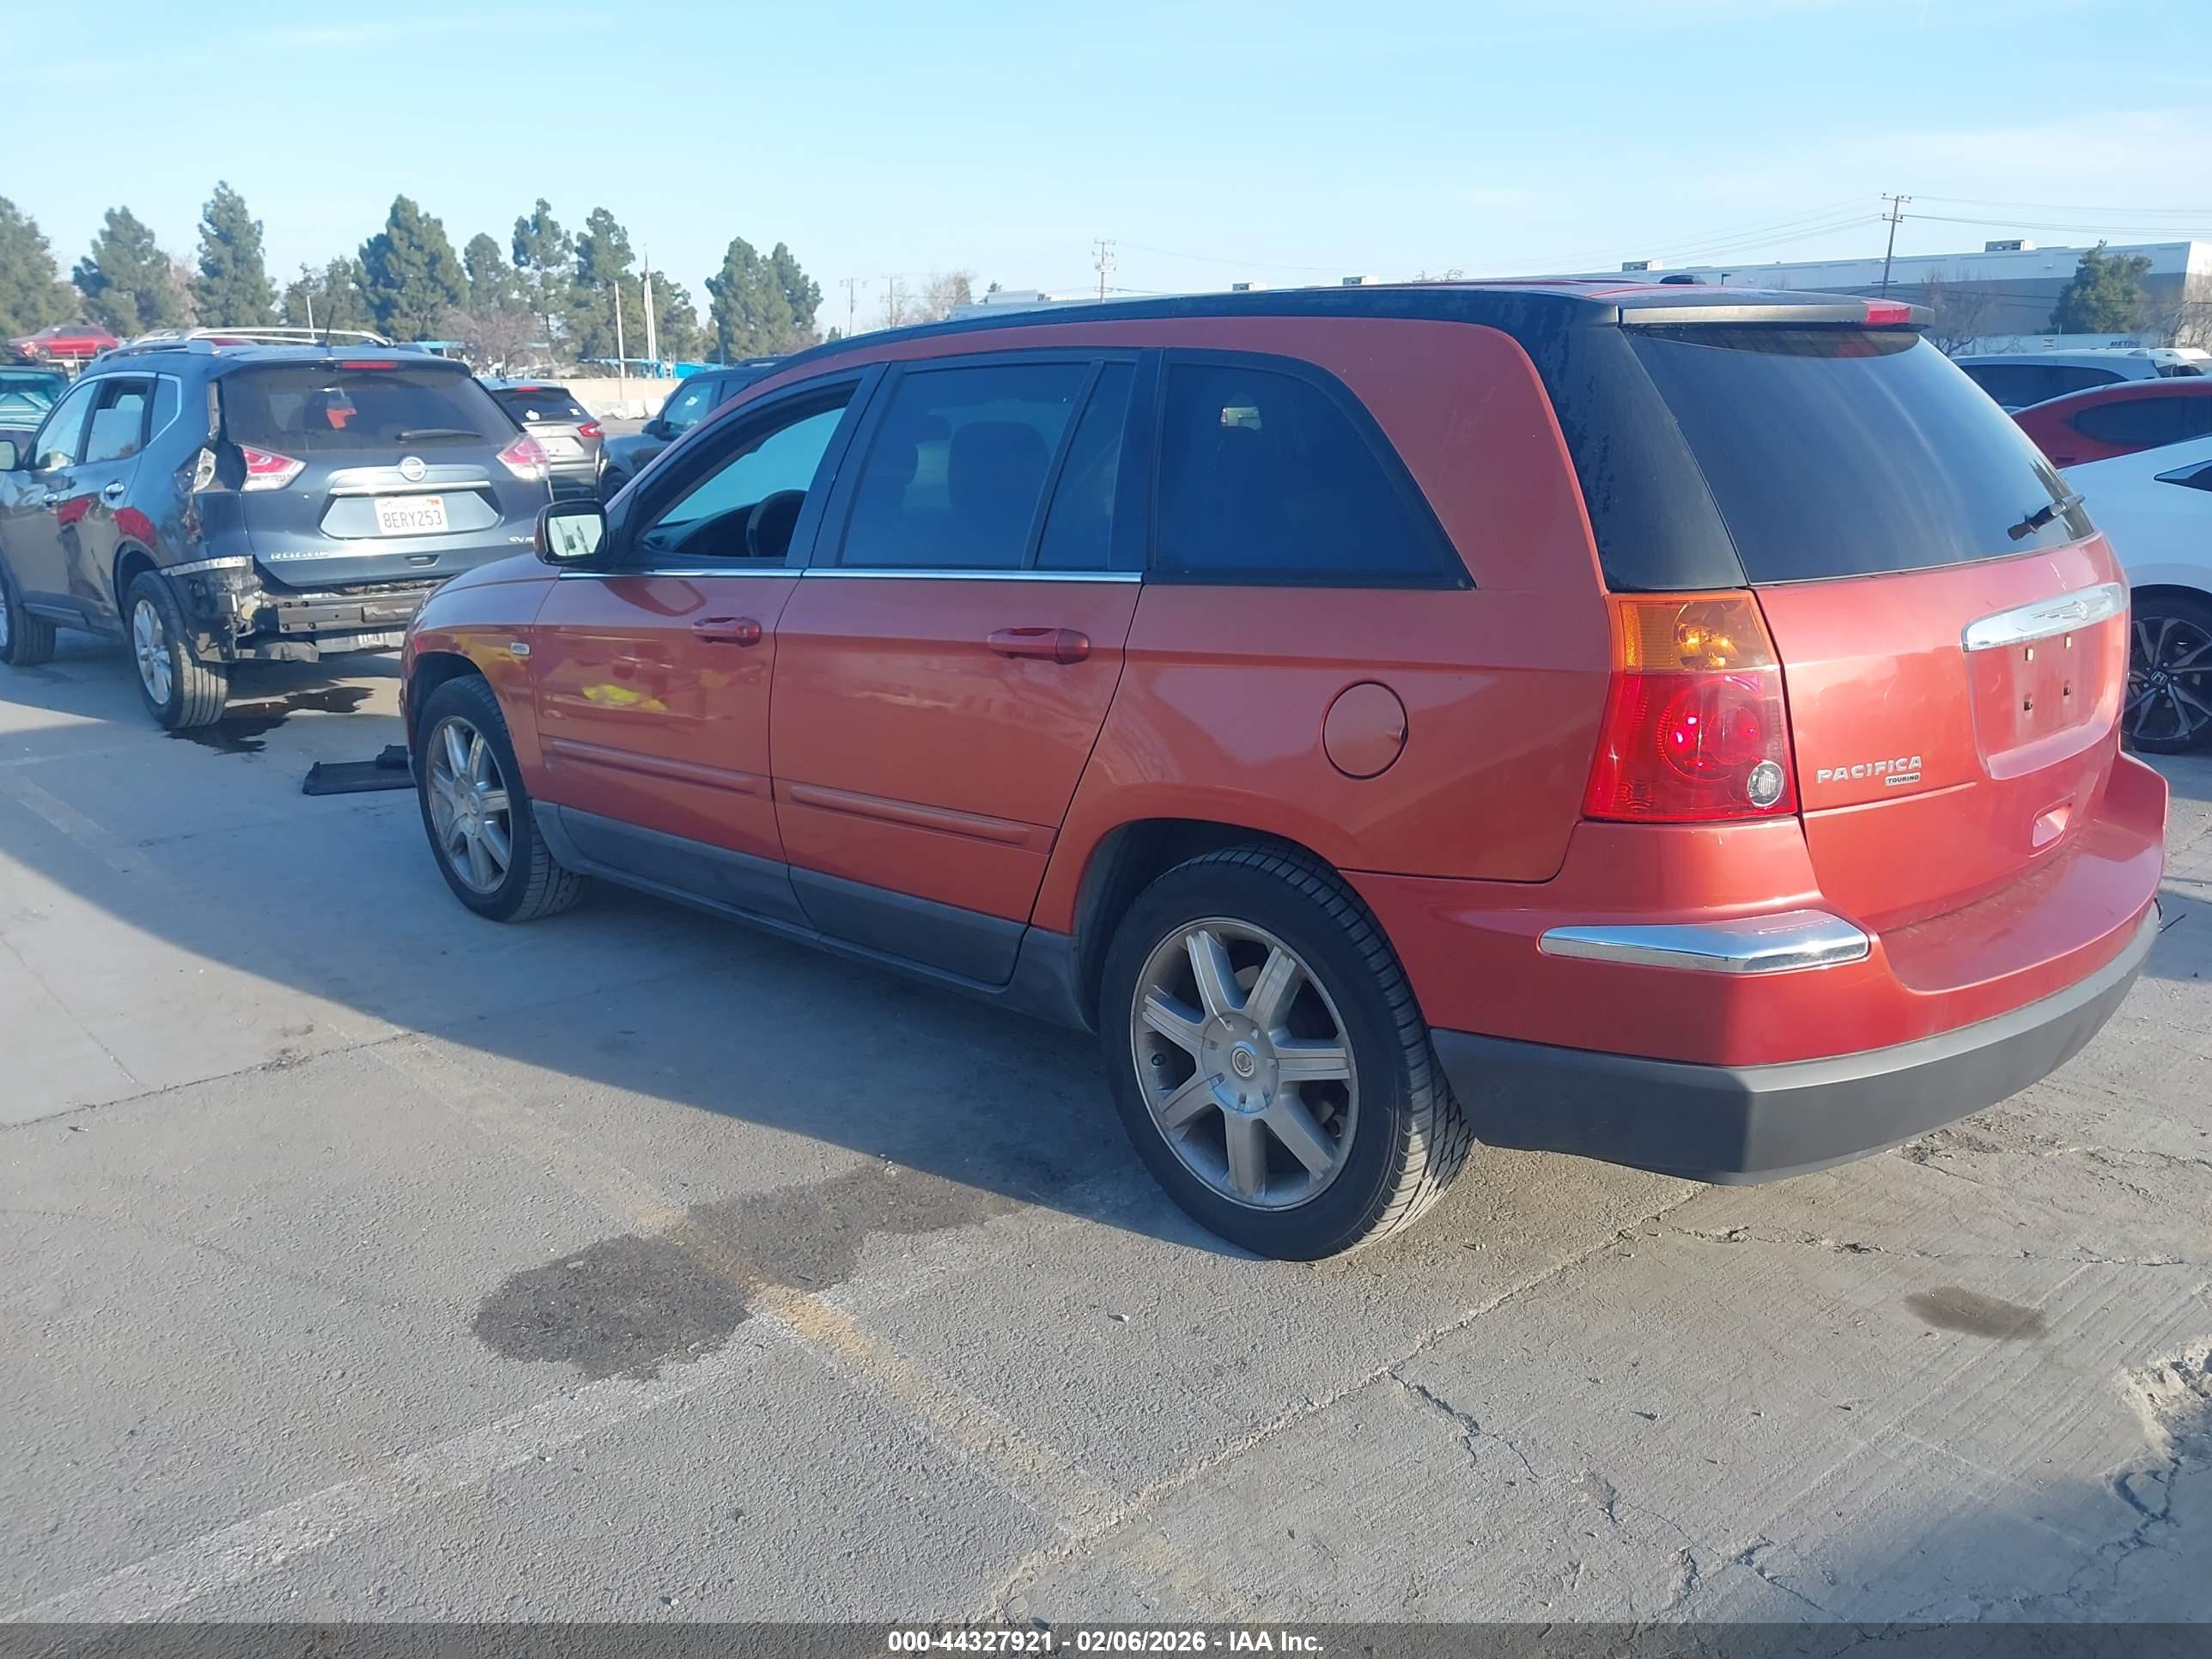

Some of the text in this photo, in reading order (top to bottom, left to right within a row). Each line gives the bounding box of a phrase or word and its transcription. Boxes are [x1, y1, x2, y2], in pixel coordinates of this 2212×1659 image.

[383, 510, 442, 528] 8ERY253
[1816, 756, 1923, 784] PACIFICA
[1887, 774, 1920, 785] TOURING
